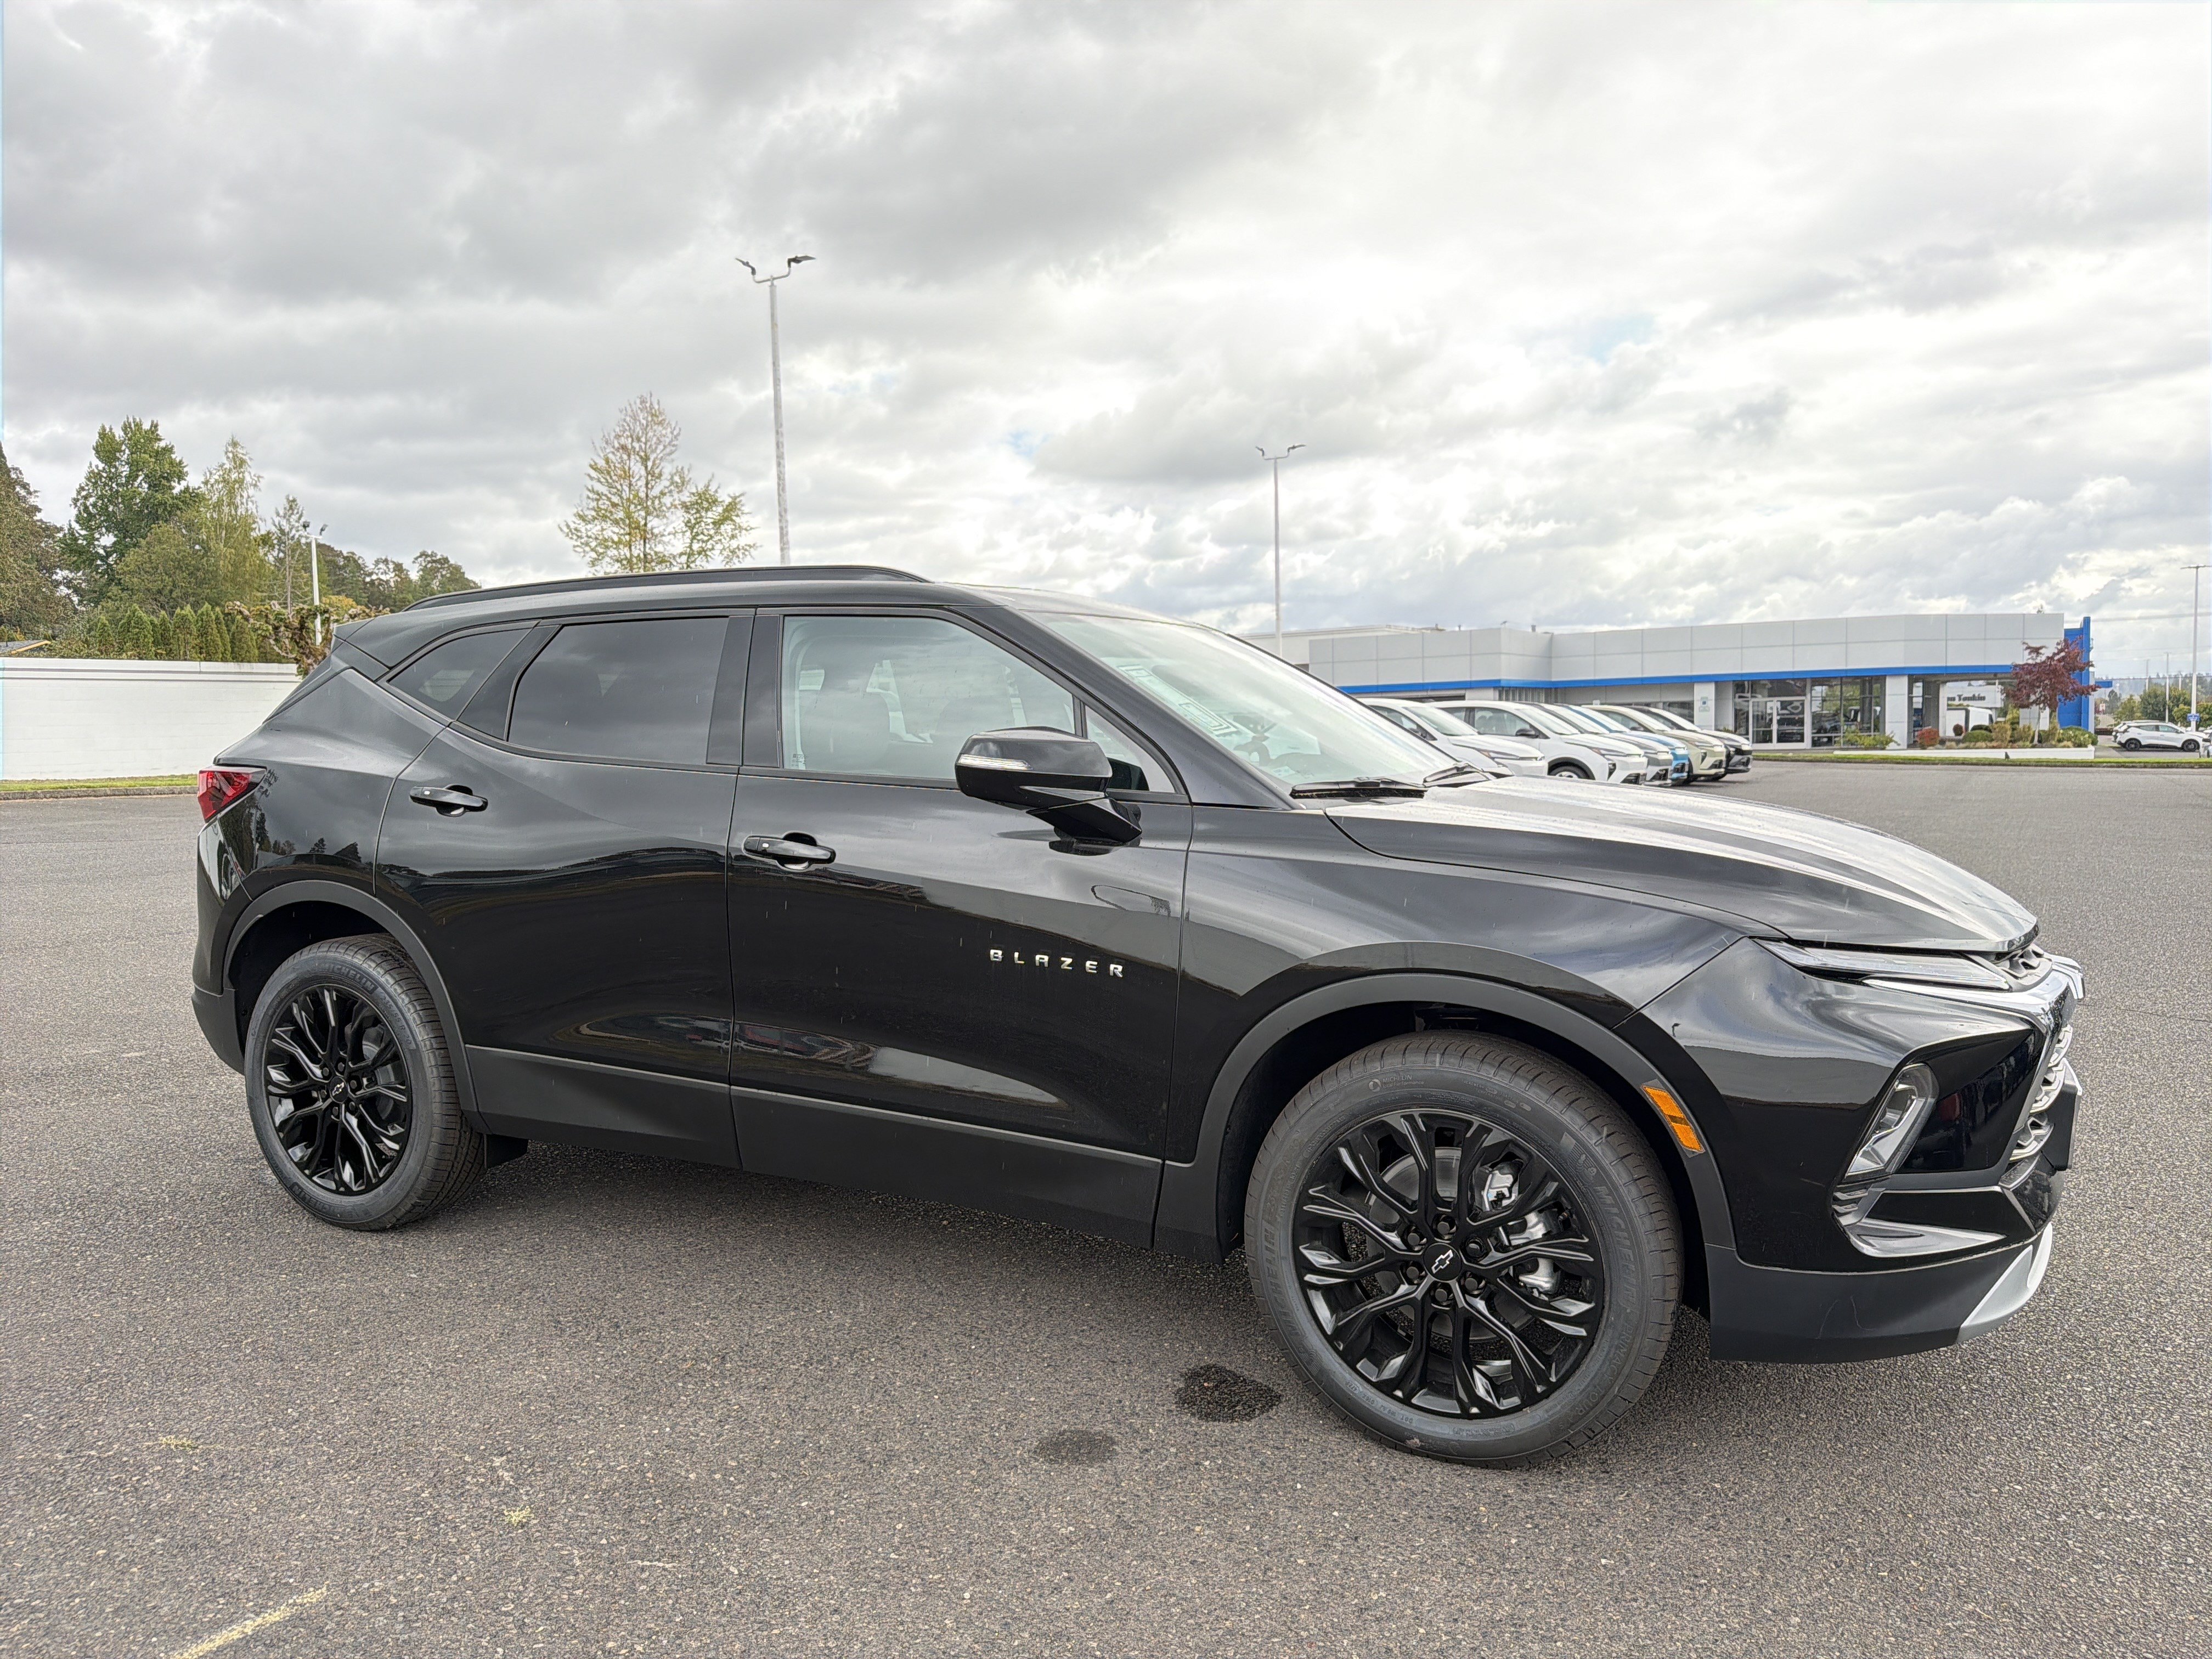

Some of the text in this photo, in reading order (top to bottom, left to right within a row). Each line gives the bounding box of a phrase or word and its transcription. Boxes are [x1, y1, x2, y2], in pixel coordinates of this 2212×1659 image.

[990, 949, 1123, 978] BLAZER
[1383, 1075, 1412, 1084] MICHELIN
[1593, 1186, 1636, 1302] MICHELIN
[1604, 1323, 1633, 1379] PRIMACY
[1575, 1385, 1602, 1415] TOUR
